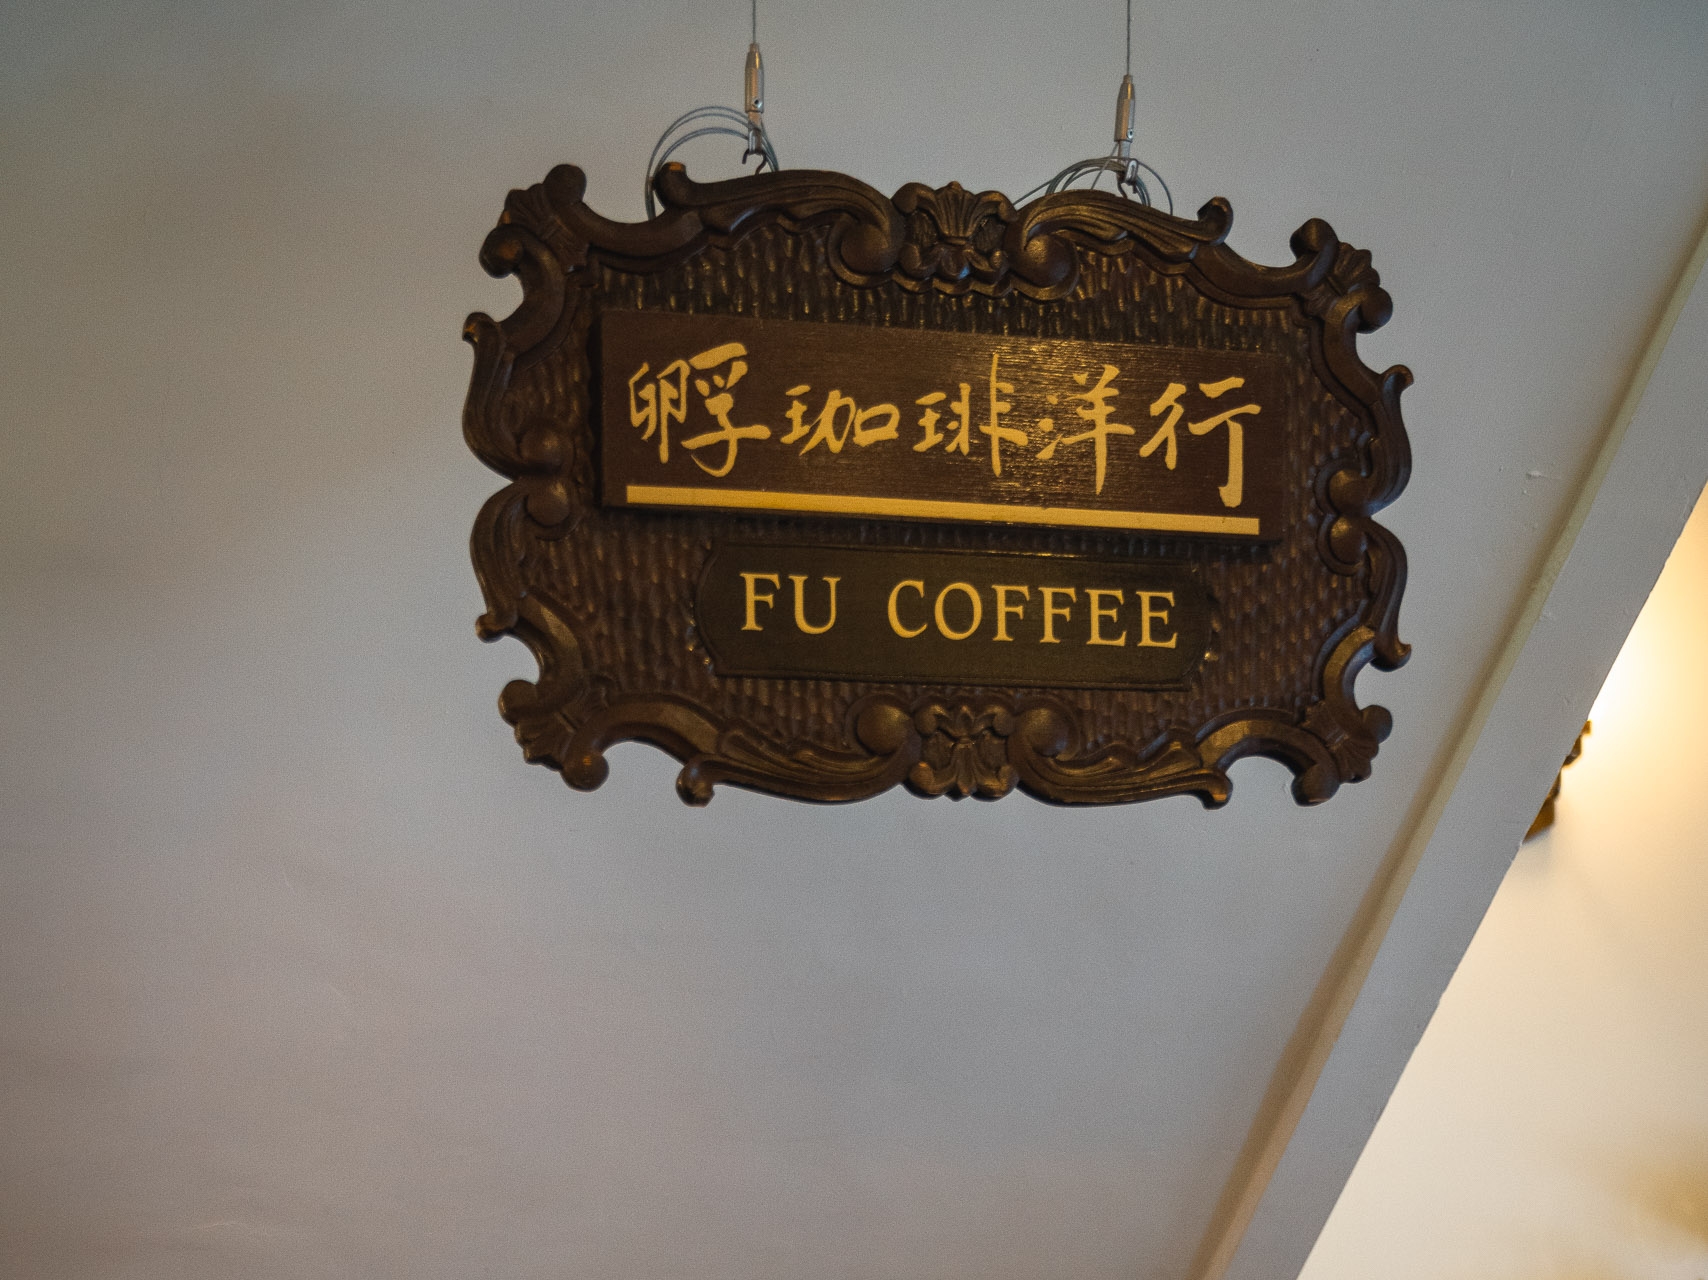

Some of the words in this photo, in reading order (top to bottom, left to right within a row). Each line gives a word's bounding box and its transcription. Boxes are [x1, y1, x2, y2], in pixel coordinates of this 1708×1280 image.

[627, 341, 1262, 509] 孵珈琲洋行
[740, 572, 840, 635] FU
[886, 578, 1179, 649] COFFEE
